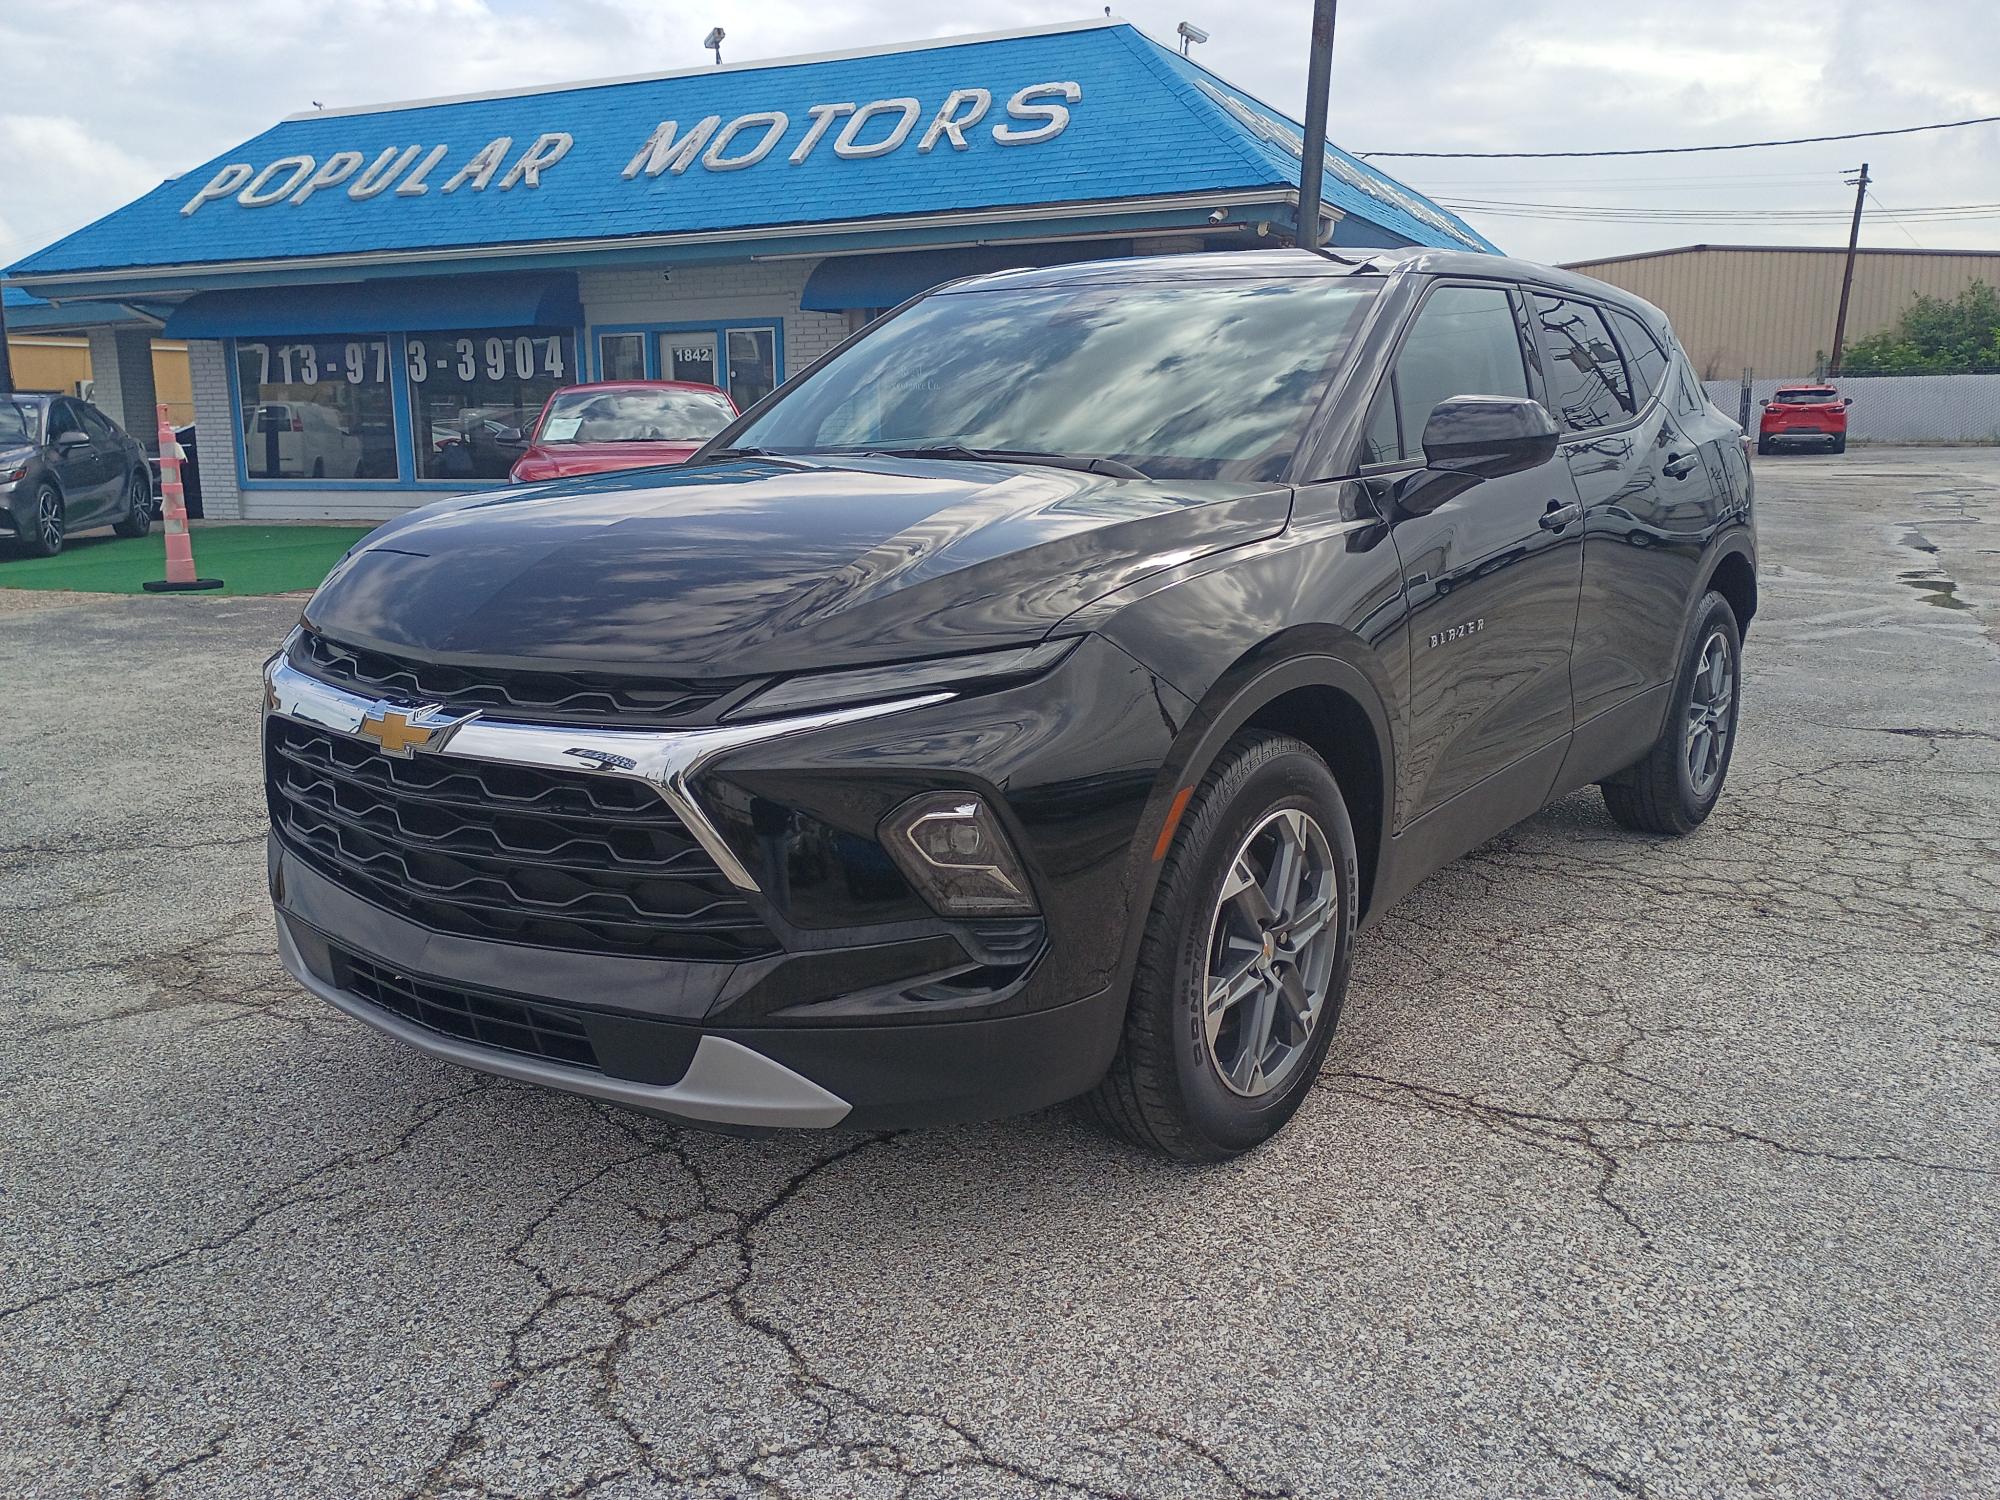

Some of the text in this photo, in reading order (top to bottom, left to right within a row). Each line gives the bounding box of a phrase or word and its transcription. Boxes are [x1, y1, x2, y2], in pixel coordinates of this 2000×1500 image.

[180, 81, 1082, 217] POPULAR MOTORS
[676, 347, 710, 362] 1842
[1430, 618, 1485, 648] BLAZER
